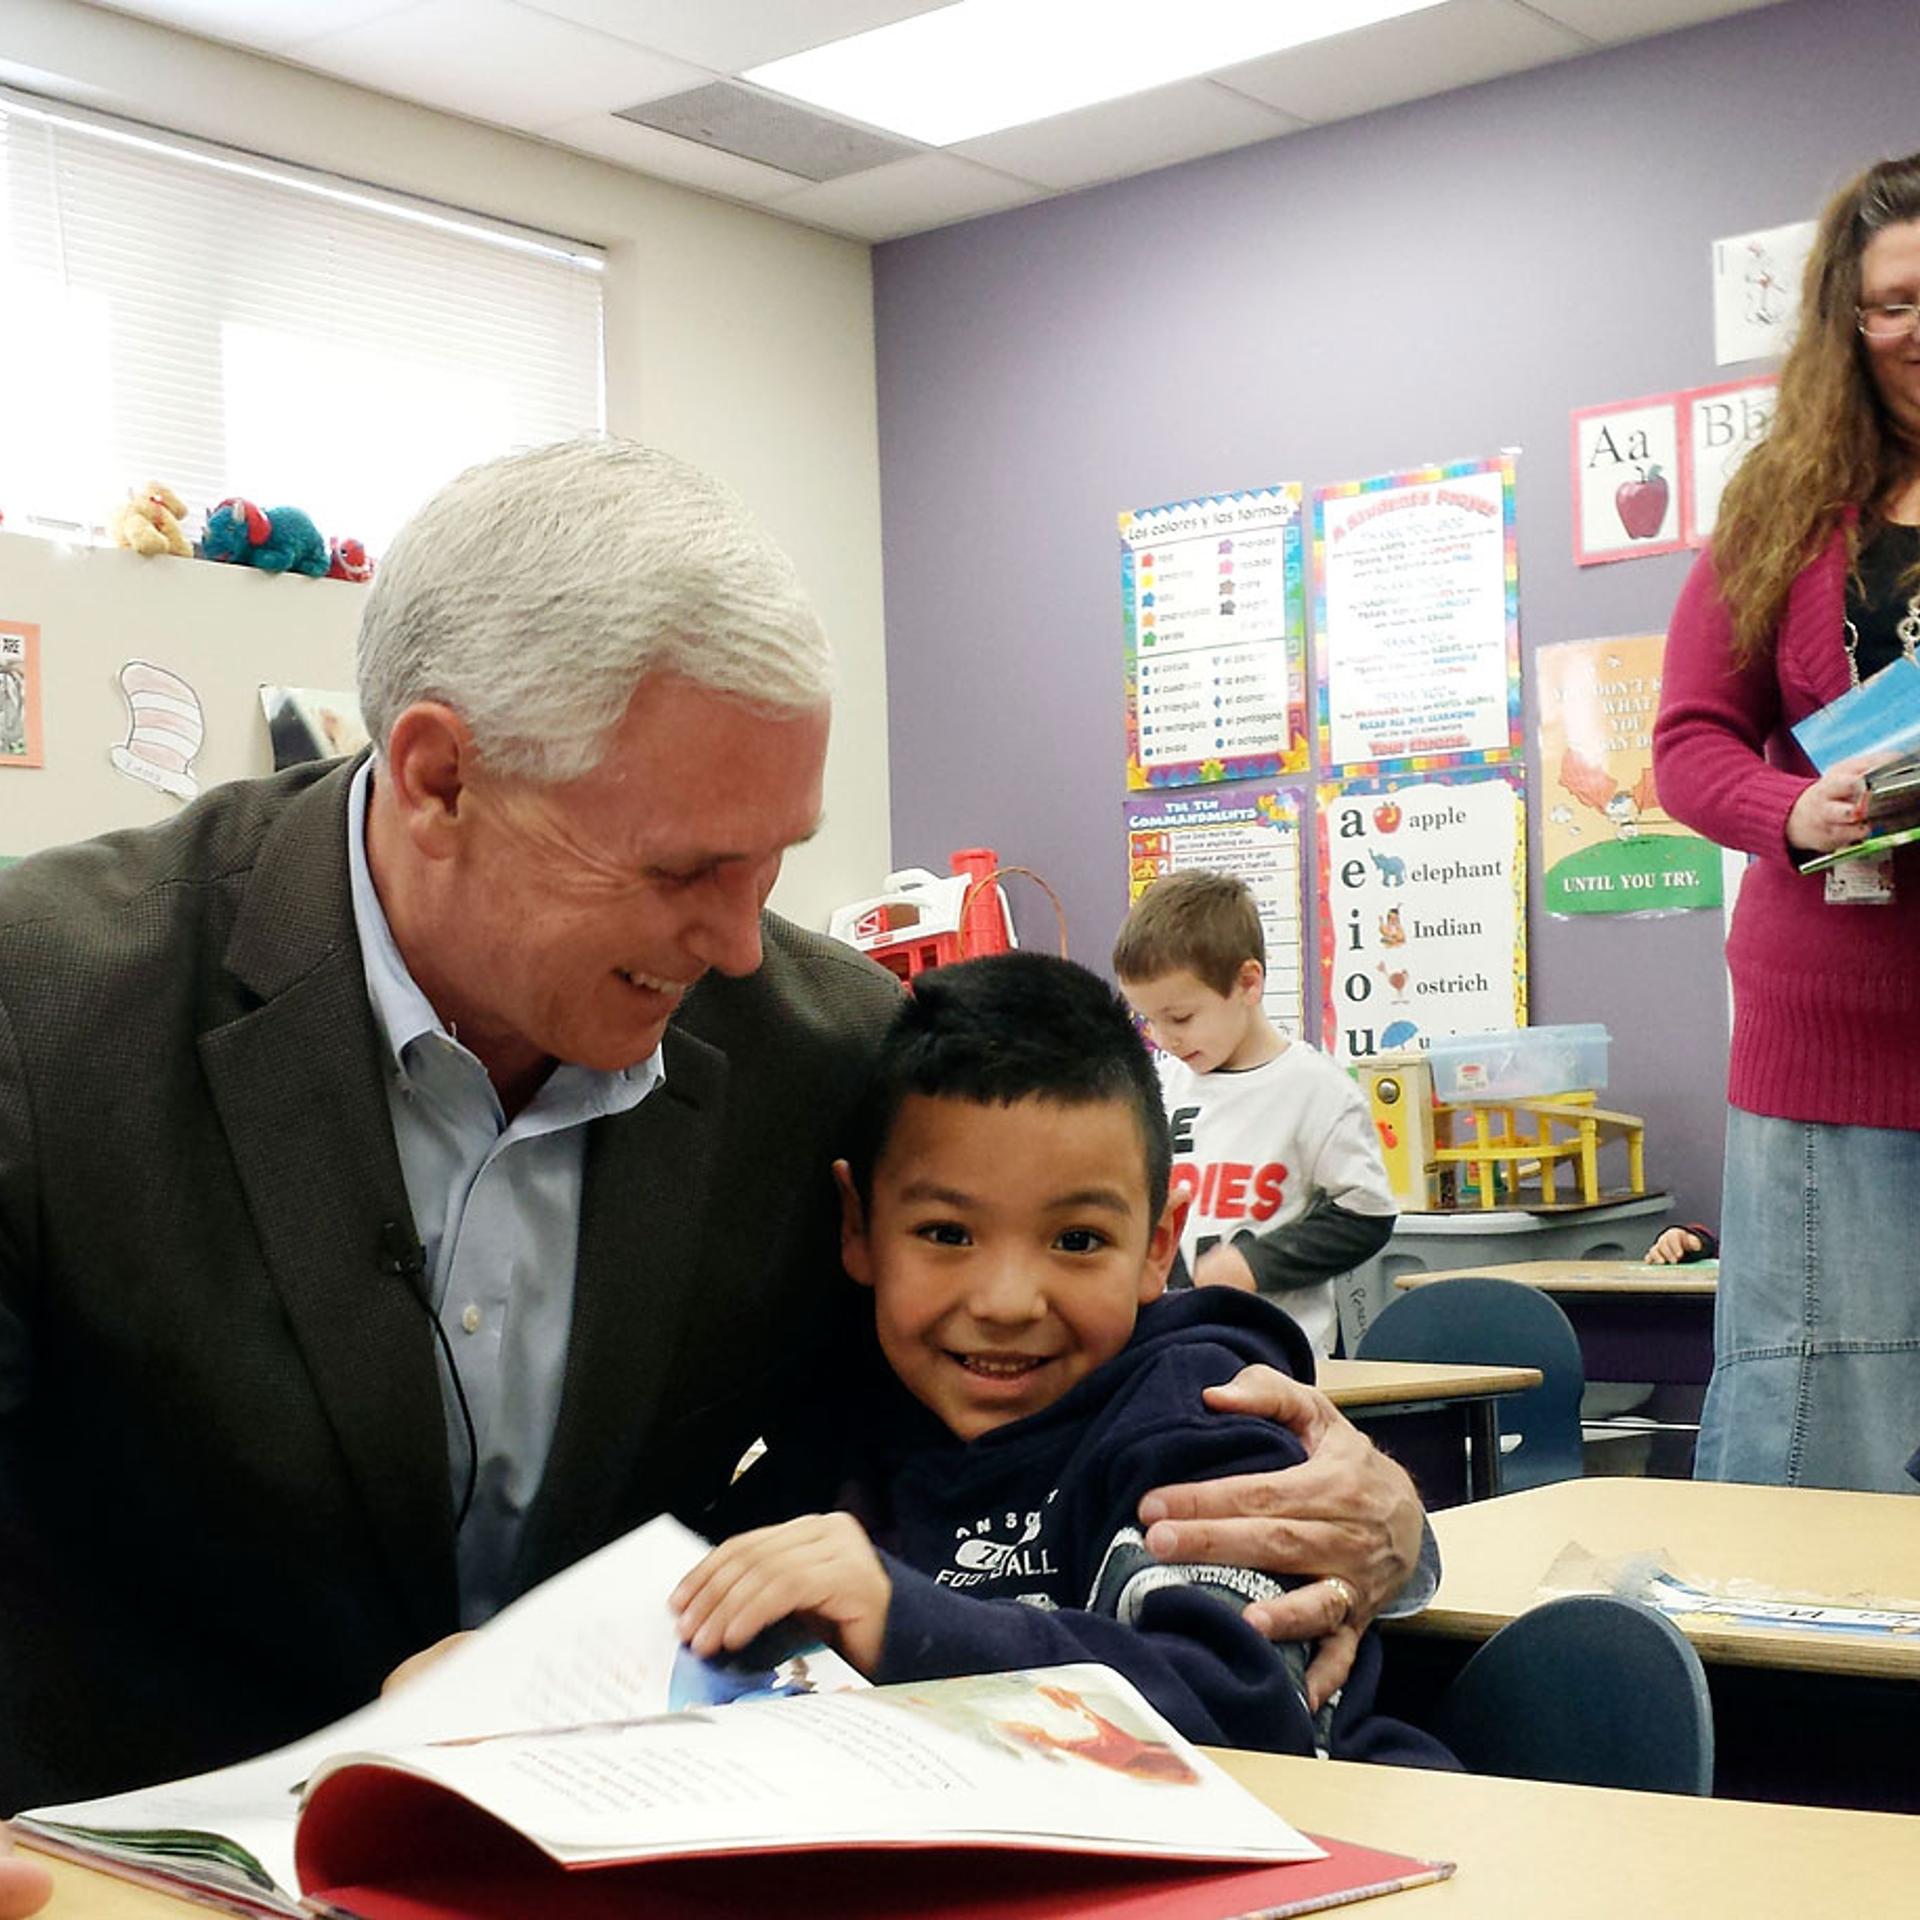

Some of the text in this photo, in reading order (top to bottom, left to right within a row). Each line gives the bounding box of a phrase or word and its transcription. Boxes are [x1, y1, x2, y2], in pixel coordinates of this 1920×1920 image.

[1702, 398, 1772, 447] Bb
[1588, 425, 1649, 468] Aa
[1129, 527, 1148, 541] Los
[1151, 516, 1197, 536] colores
[1213, 511, 1234, 525] las
[1238, 504, 1289, 521] formas
[1601, 699, 1652, 715] WHAT
[1612, 717, 1641, 732] YOU
[1129, 808, 1257, 828] COMMANDMENTS
[1193, 800, 1219, 811] TEN
[1340, 808, 1366, 838] a
[1409, 806, 1467, 831] apple
[1341, 860, 1366, 889] e
[1411, 860, 1502, 885] elephant
[1563, 870, 1700, 892] UNTIL YOU TRY.
[1349, 908, 1364, 951] i
[1413, 919, 1483, 939] Indian
[1345, 973, 1371, 1002] o
[1416, 974, 1489, 995] ostrich
[1346, 1028, 1378, 1057] u
